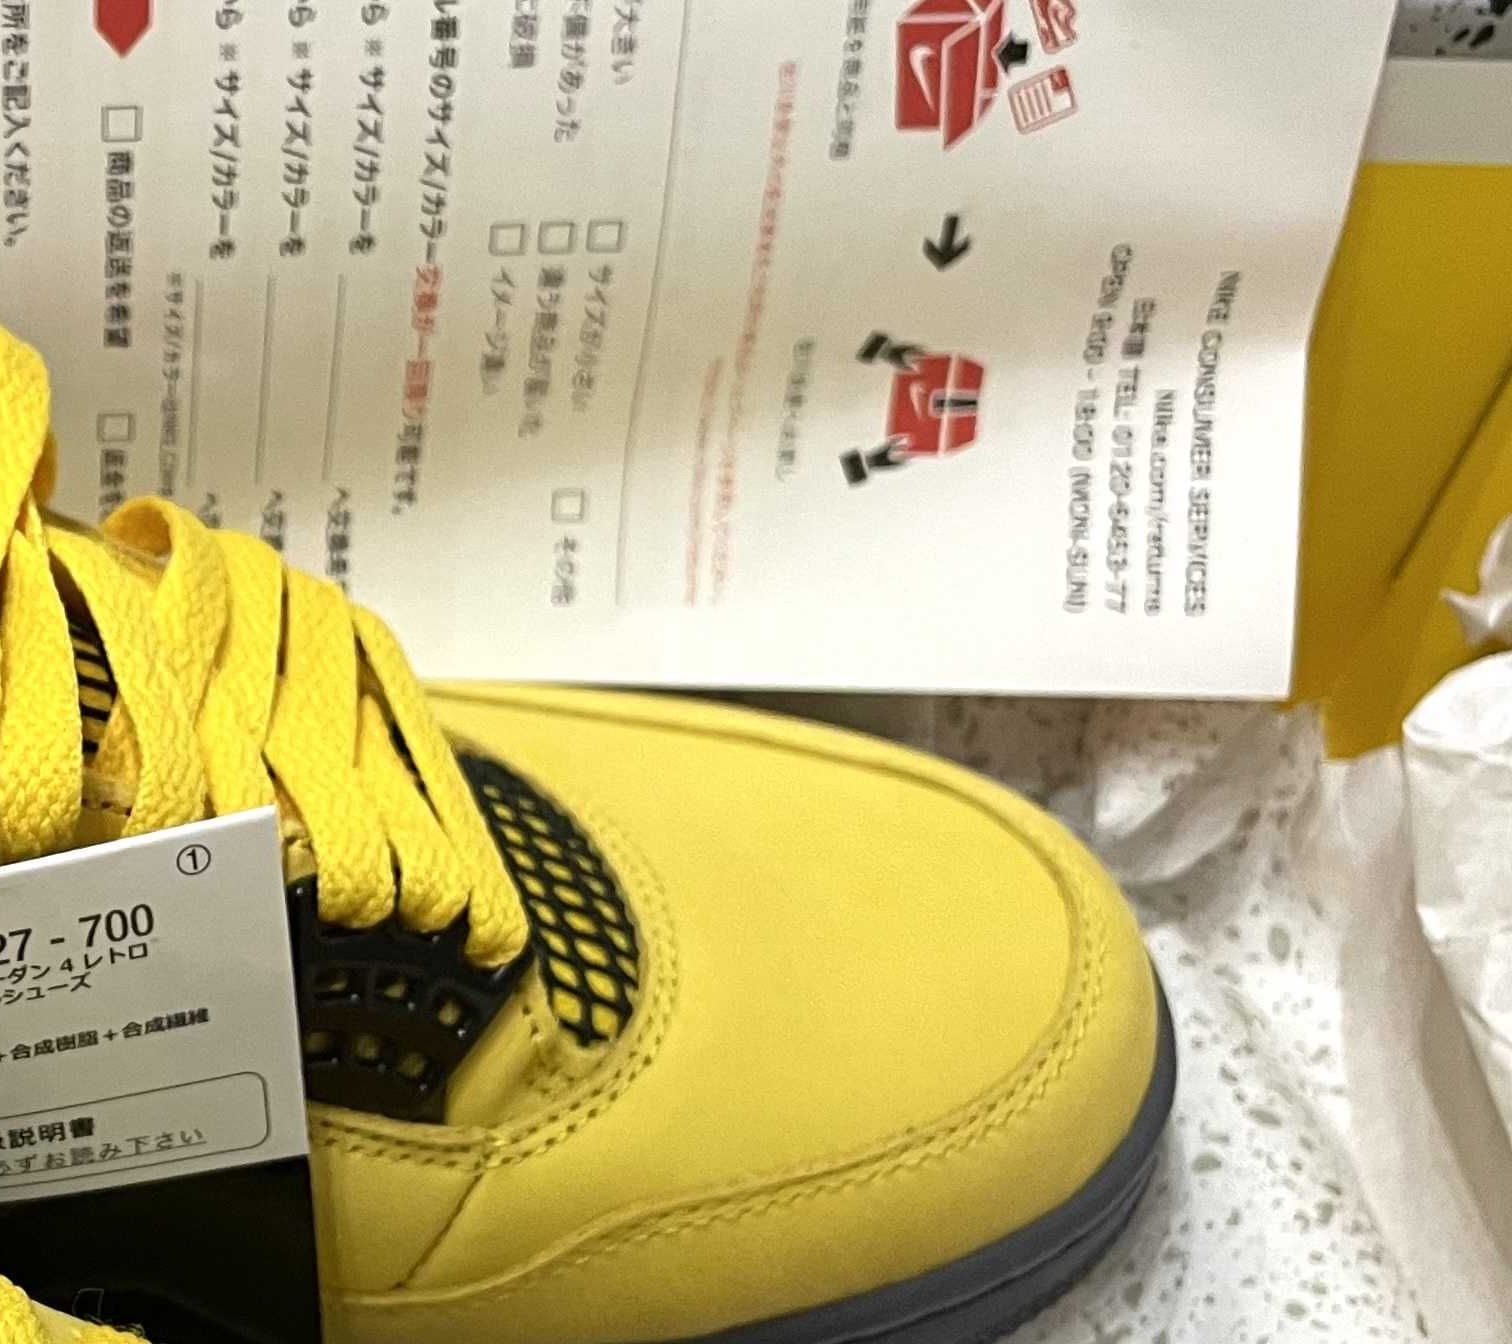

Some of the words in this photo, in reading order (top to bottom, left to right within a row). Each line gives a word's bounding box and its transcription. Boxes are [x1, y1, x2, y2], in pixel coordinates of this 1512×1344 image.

[210, 71, 241, 259] サイズ/カラーを
[280, 69, 313, 257] サイズ/カラーを
[349, 66, 388, 256] サイズ/カラーを
[60, 956, 74, 972] 4
[84, 941, 149, 969] レトロ
[78, 904, 155, 951] 700
